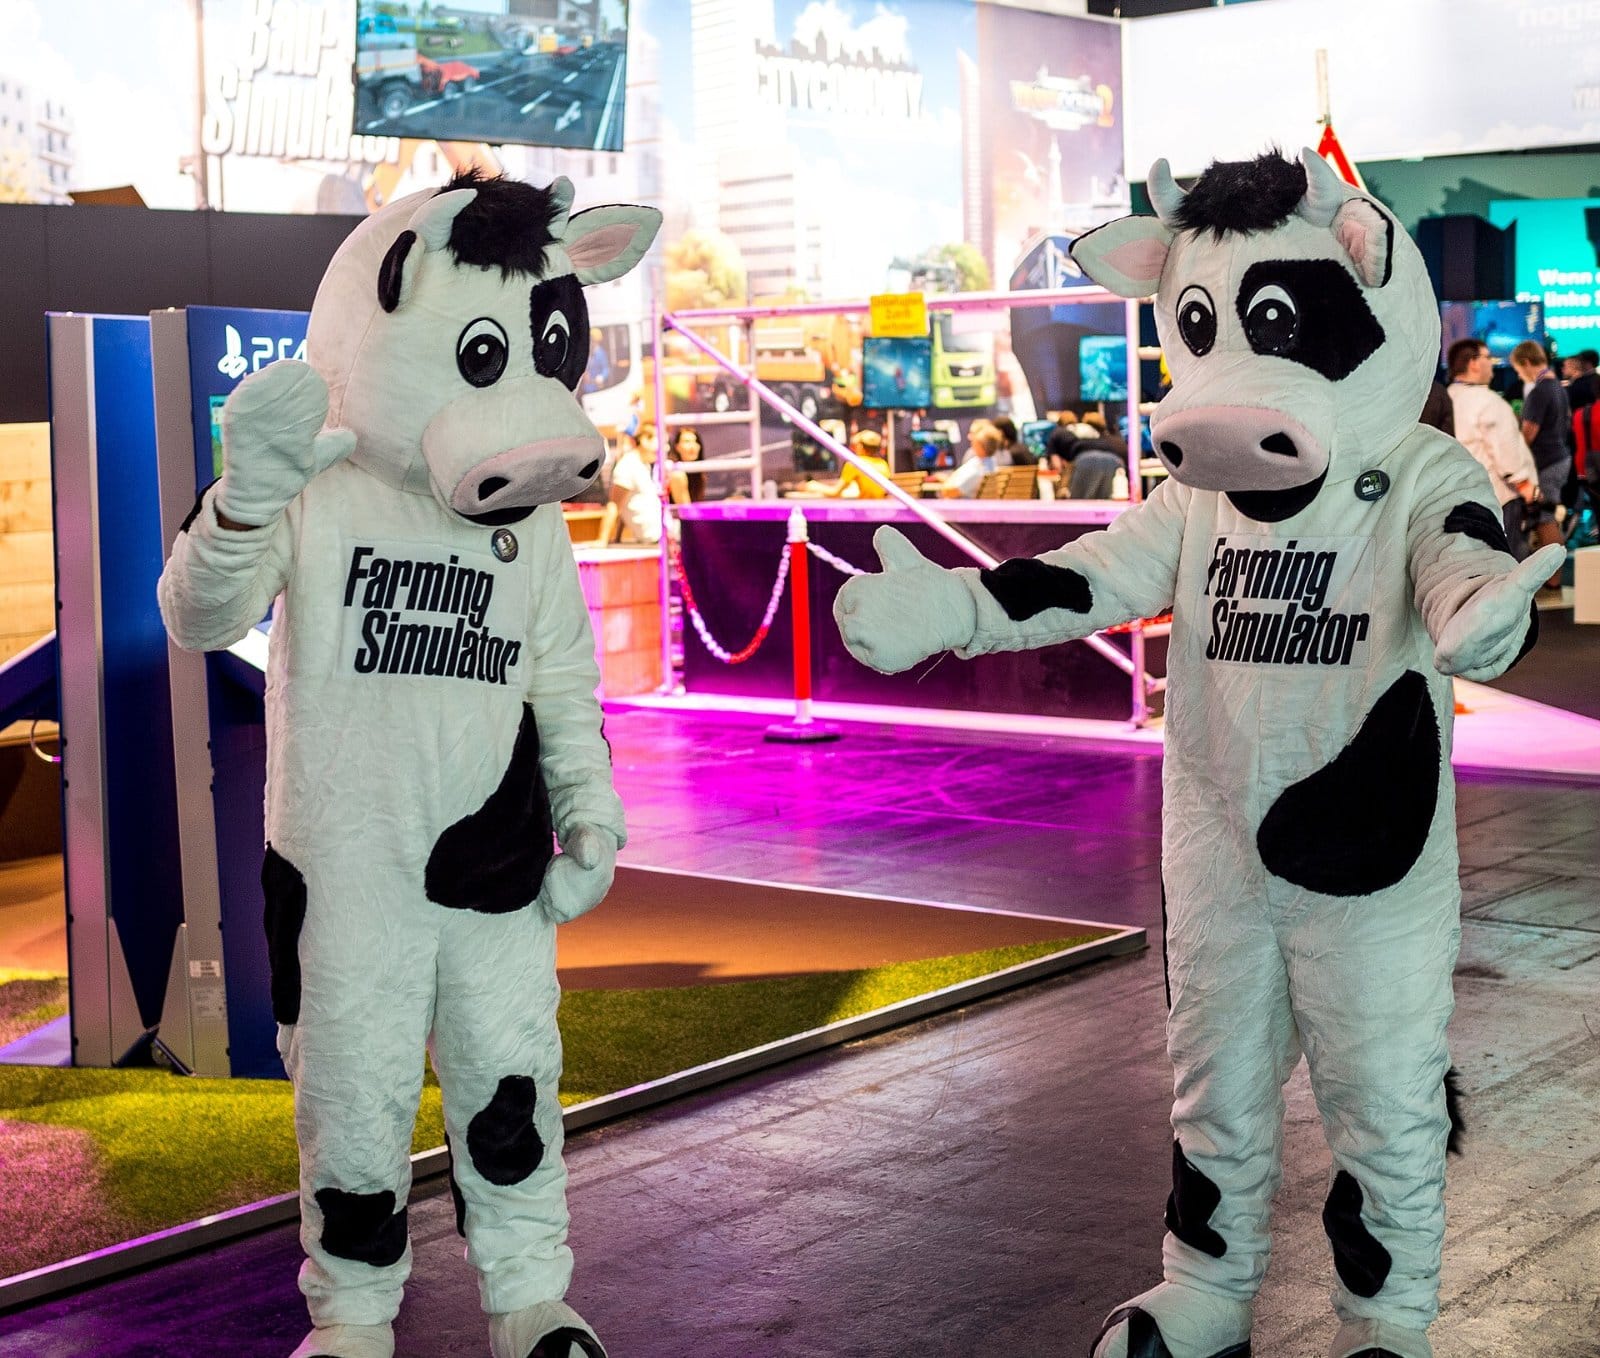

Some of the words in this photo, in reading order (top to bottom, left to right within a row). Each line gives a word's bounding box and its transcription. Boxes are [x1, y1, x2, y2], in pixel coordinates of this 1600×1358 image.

[1538, 269, 1593, 286] Wenn
[1544, 291, 1592, 307] linke
[344, 546, 495, 629] Farming
[1205, 537, 1338, 612] Farming
[354, 610, 522, 685] Simulator
[1206, 598, 1370, 666] Simulator
